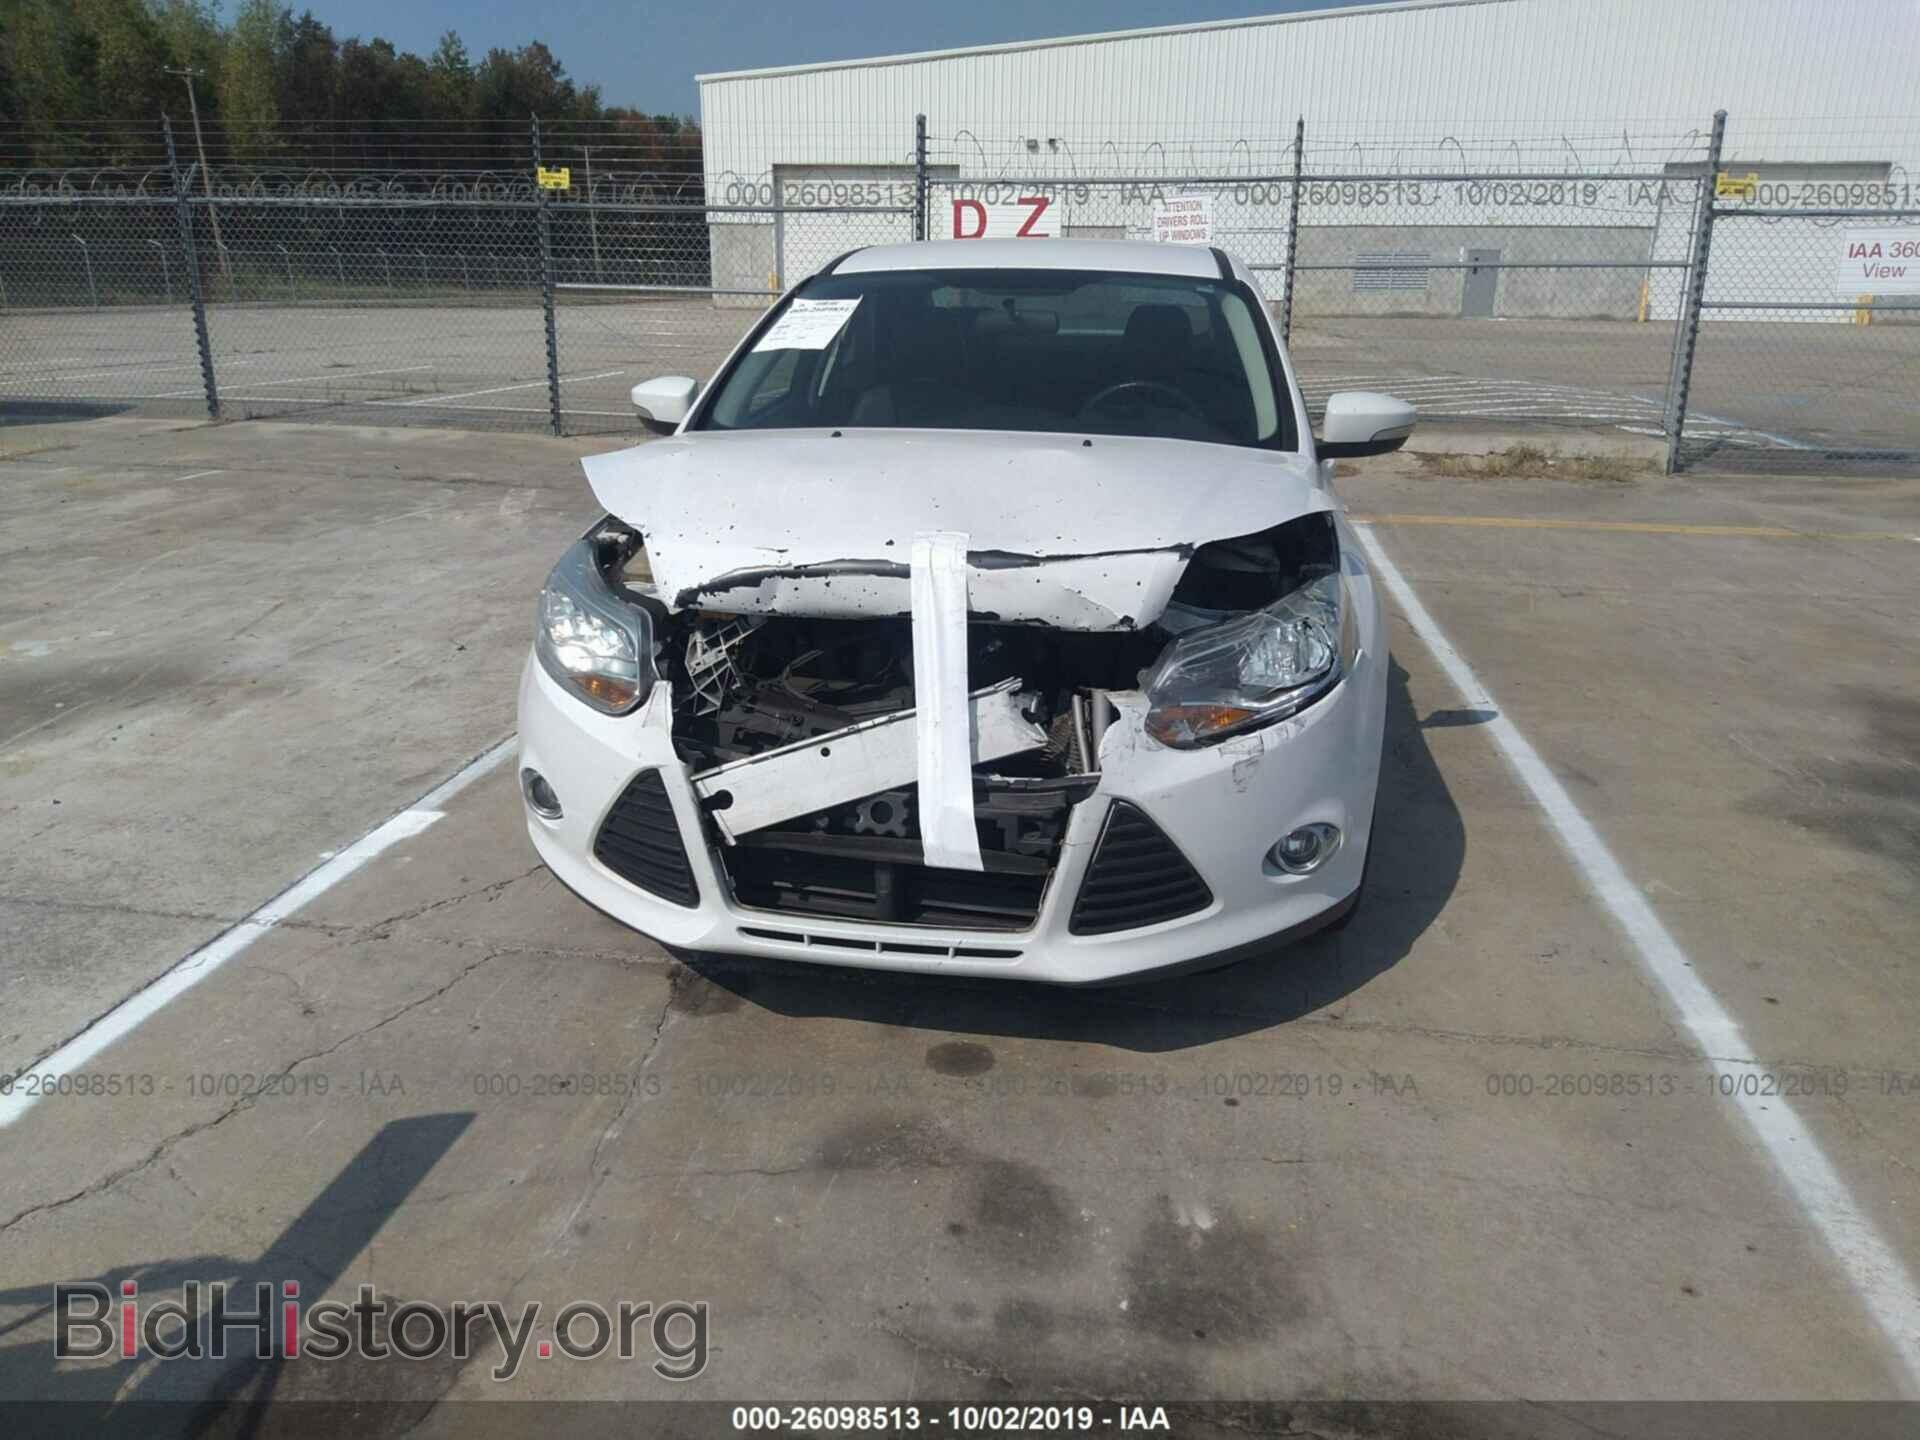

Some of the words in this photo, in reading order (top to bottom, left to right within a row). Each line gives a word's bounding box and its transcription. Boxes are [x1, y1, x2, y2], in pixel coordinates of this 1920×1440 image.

[953, 199, 987, 239] D
[1016, 197, 1050, 238] Z
[1157, 215, 1188, 228] DRIVERS
[1190, 214, 1209, 225] ROLL
[1159, 231, 1169, 241] UP
[1171, 228, 1206, 241] WINDOWS
[1849, 243, 1882, 258] IAA
[1863, 263, 1906, 278] View
